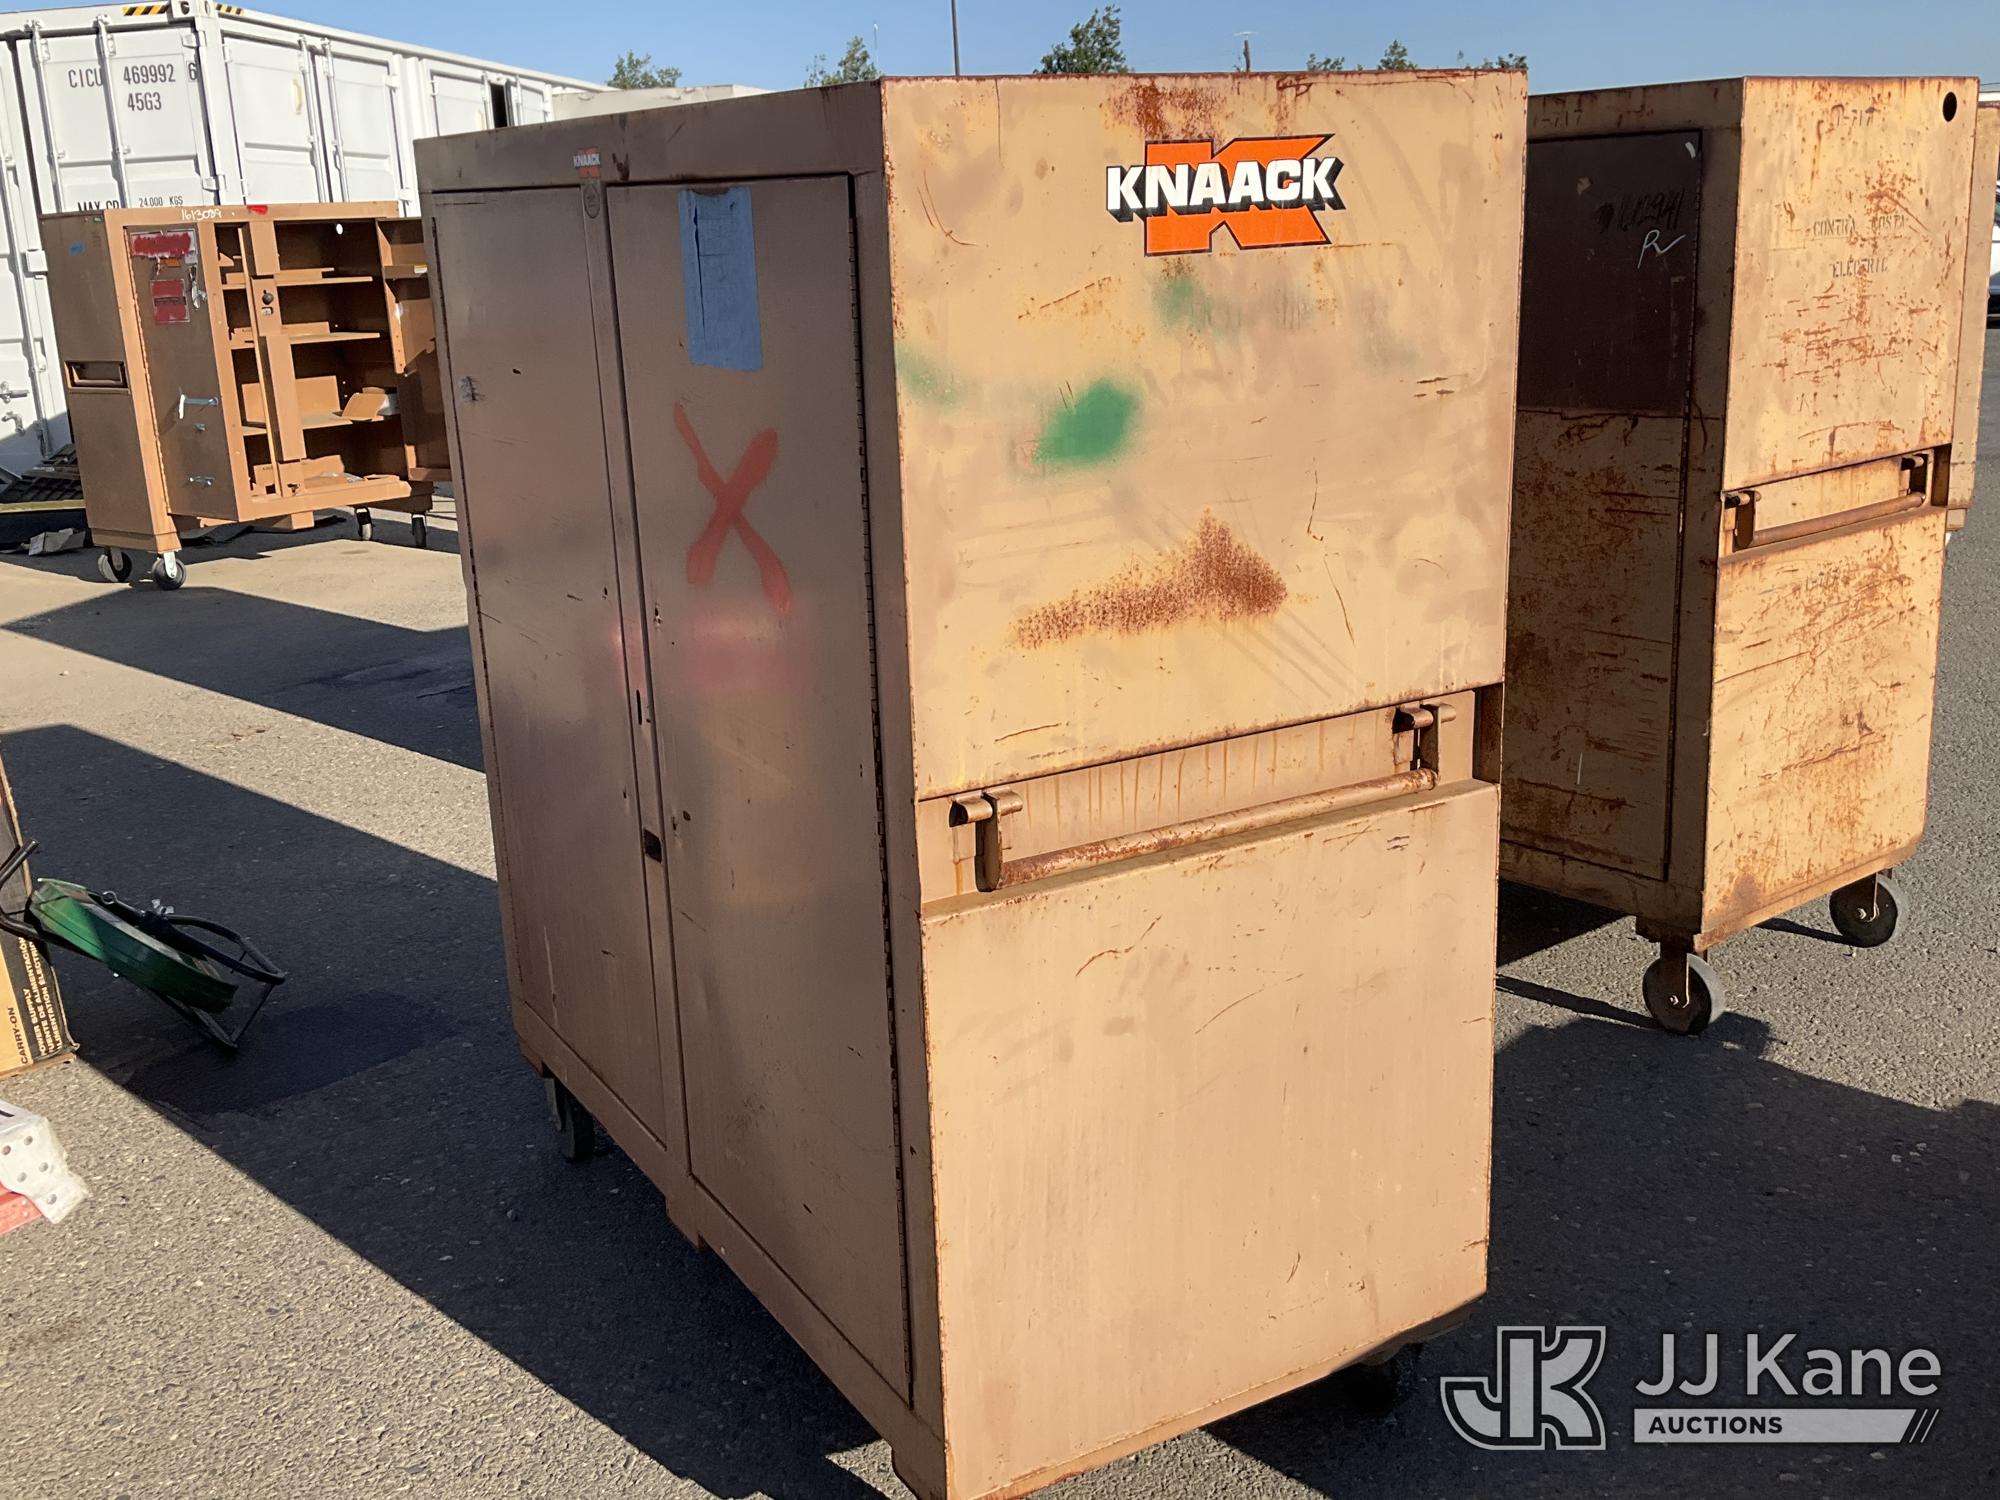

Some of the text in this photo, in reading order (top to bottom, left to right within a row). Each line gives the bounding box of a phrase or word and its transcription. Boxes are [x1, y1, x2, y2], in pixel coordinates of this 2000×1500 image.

[68, 62, 197, 88] CICU 469992 6
[127, 92, 162, 111] 45G3
[574, 153, 600, 169] KNAACK
[1106, 157, 1344, 216] KNAACK
[168, 195, 184, 206] KGS
[23, 988, 38, 1024] SUPPLY
[37, 1003, 46, 1019] DE
[7, 1007, 28, 1064] CARRY-ON
